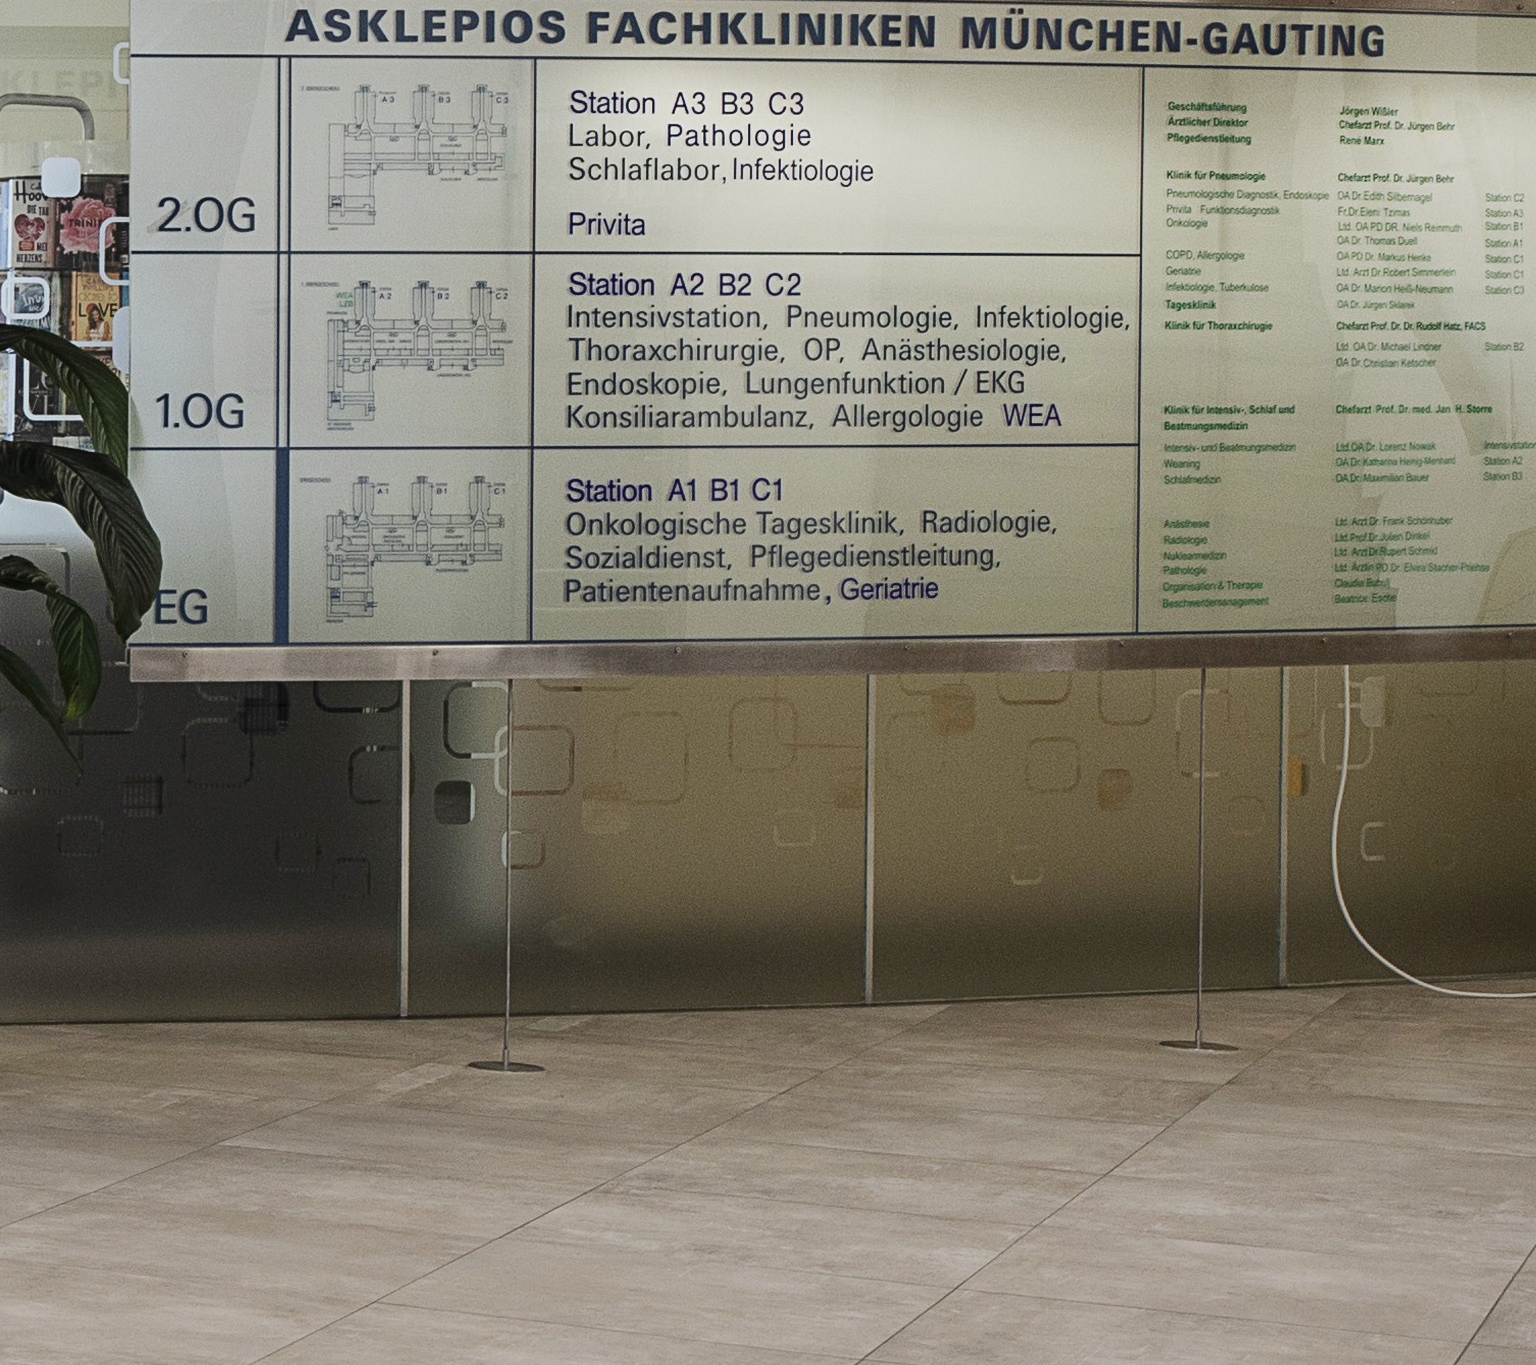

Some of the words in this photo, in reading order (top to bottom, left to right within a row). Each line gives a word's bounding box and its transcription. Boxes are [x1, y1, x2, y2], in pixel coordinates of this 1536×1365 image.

[284, 8, 566, 45] ASKLEPIOS
[587, 11, 936, 48] FACHKLINIKEN
[961, 5, 1387, 58] MÜNCHEN-GAUTING
[569, 89, 656, 115] Station
[671, 91, 706, 115] A3
[721, 91, 754, 116] B3
[768, 91, 804, 116] C3
[1213, 117, 1249, 127] Direktor
[1394, 121, 1406, 130] Dr.
[568, 122, 651, 150] Labor,
[666, 123, 812, 152] Pathologie
[1167, 133, 1252, 145] Pflegedienstleitung
[1364, 136, 1385, 145] Marx
[568, 156, 727, 184] Schlaflabor,
[733, 157, 874, 188] Infektiologie
[1166, 170, 1192, 180] Klinik
[1194, 170, 1207, 180] für
[1209, 171, 1266, 183] Pneumologie
[1393, 174, 1404, 183] Dr.
[1485, 193, 1512, 202] Station
[1513, 193, 1525, 202] C2
[68, 219, 102, 228] TRINI
[157, 196, 255, 233] 2.OG
[568, 211, 646, 236] Privita
[1166, 218, 1208, 230] Onkologie
[1485, 209, 1512, 218] Station
[568, 271, 655, 297] Station
[669, 272, 704, 297] A2
[718, 272, 752, 297] B2
[765, 272, 802, 297] C2
[1166, 299, 1217, 311] Tagesklinik
[567, 303, 768, 331] Intensivstation,
[787, 304, 959, 334] Pneumologie,
[976, 304, 1130, 335] Infektiologie,
[1165, 321, 1190, 330] Klinik
[1192, 321, 1205, 330] für
[567, 337, 785, 367] Thoraxchirurgie,
[803, 336, 844, 364] OP,
[861, 337, 1066, 367] Anästhesiologie,
[567, 370, 727, 400] Endoskopie,
[745, 370, 945, 401] Lungenfunktion
[976, 370, 1025, 395] EKG
[155, 392, 244, 429] 1.OG
[566, 404, 814, 430] Konsiliarambulanz,
[831, 402, 984, 434] Allergologie
[1002, 403, 1062, 427] WEA
[1164, 405, 1189, 414] Klinik
[1192, 405, 1205, 414] für
[566, 478, 653, 503] Station
[667, 478, 696, 502] A1
[710, 478, 739, 502] B1
[751, 477, 782, 502] C1
[564, 511, 747, 542] Onkologische
[755, 509, 905, 541] Tagesklinik,
[921, 509, 1057, 539] Radiologie,
[564, 544, 732, 571] Sozialdienst,
[750, 542, 1001, 574] Pflegedienstleitung,
[563, 577, 833, 607] Patientenaufnahme,
[840, 576, 939, 601] Geriatrie
[155, 588, 209, 626] EG
